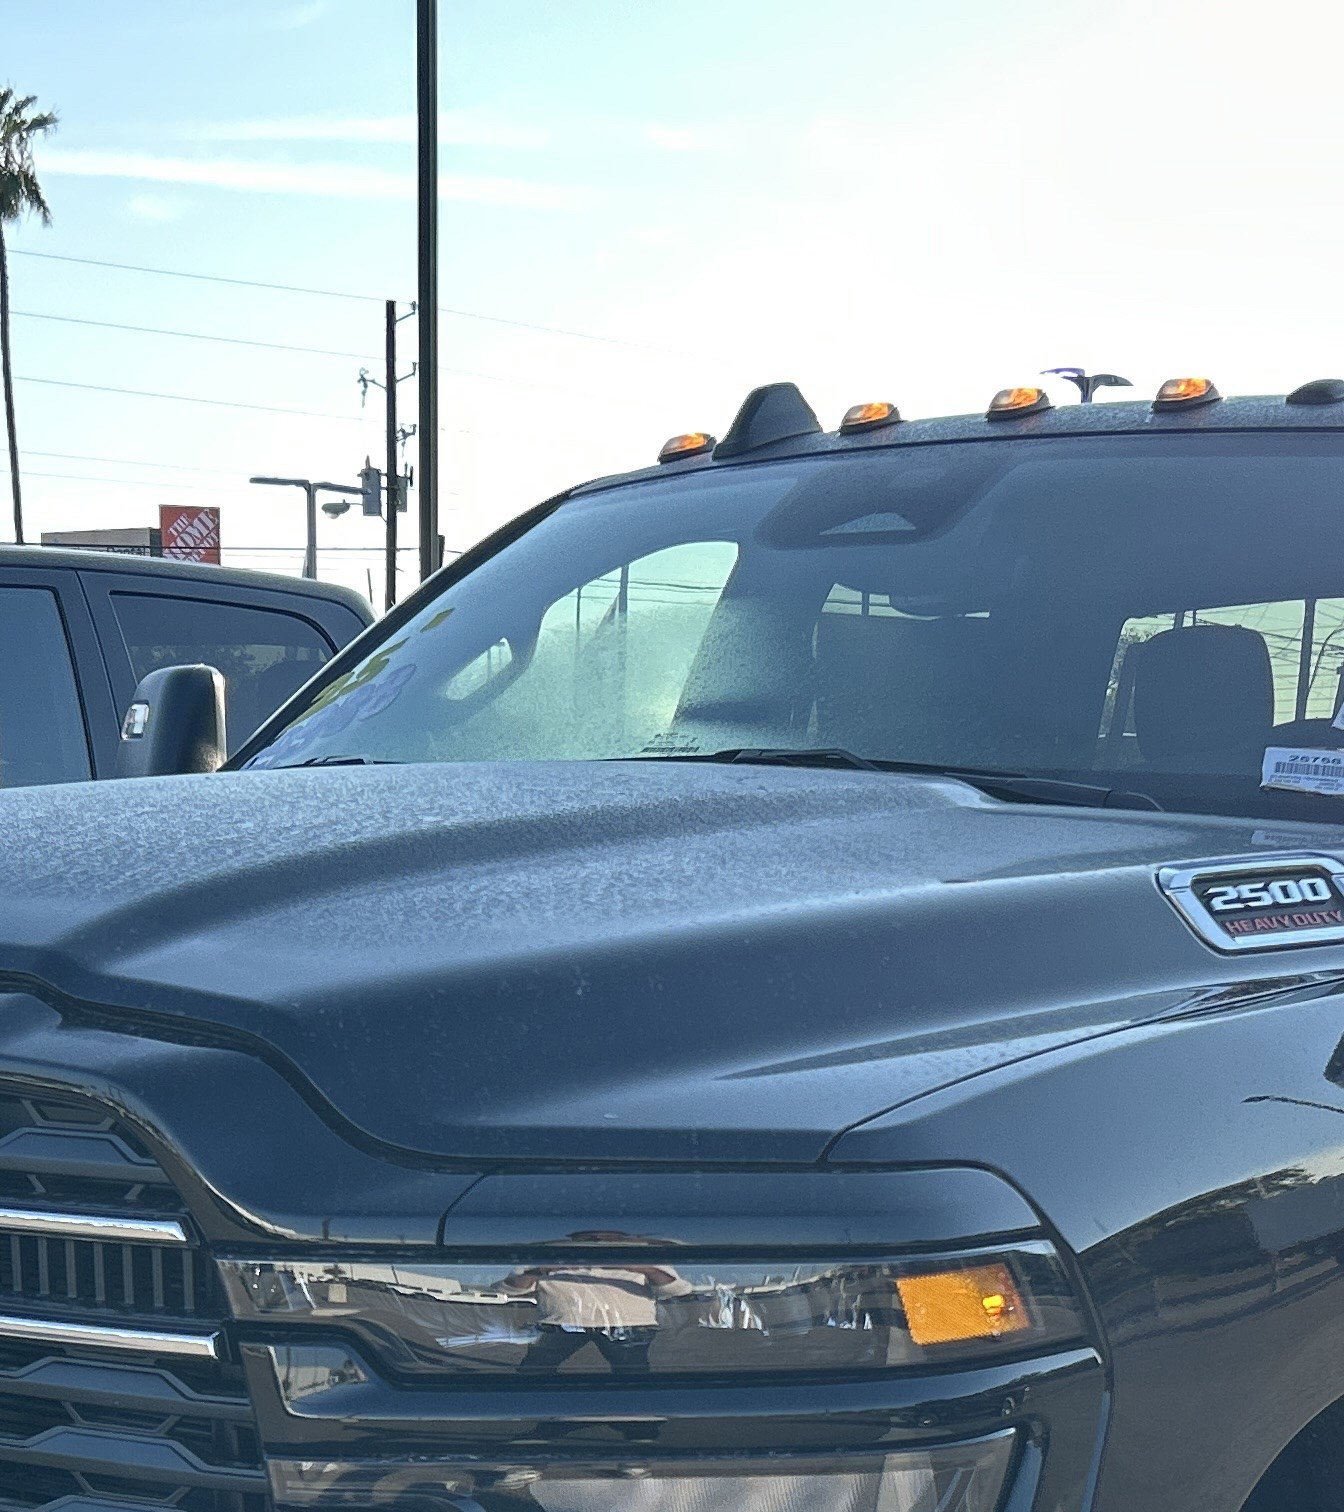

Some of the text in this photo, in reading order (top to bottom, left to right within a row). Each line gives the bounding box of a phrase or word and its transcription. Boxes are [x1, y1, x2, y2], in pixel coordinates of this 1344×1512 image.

[168, 512, 191, 537] THE
[1205, 878, 1332, 912] 2500
[1224, 909, 1344, 934] HEAVY DUTY
